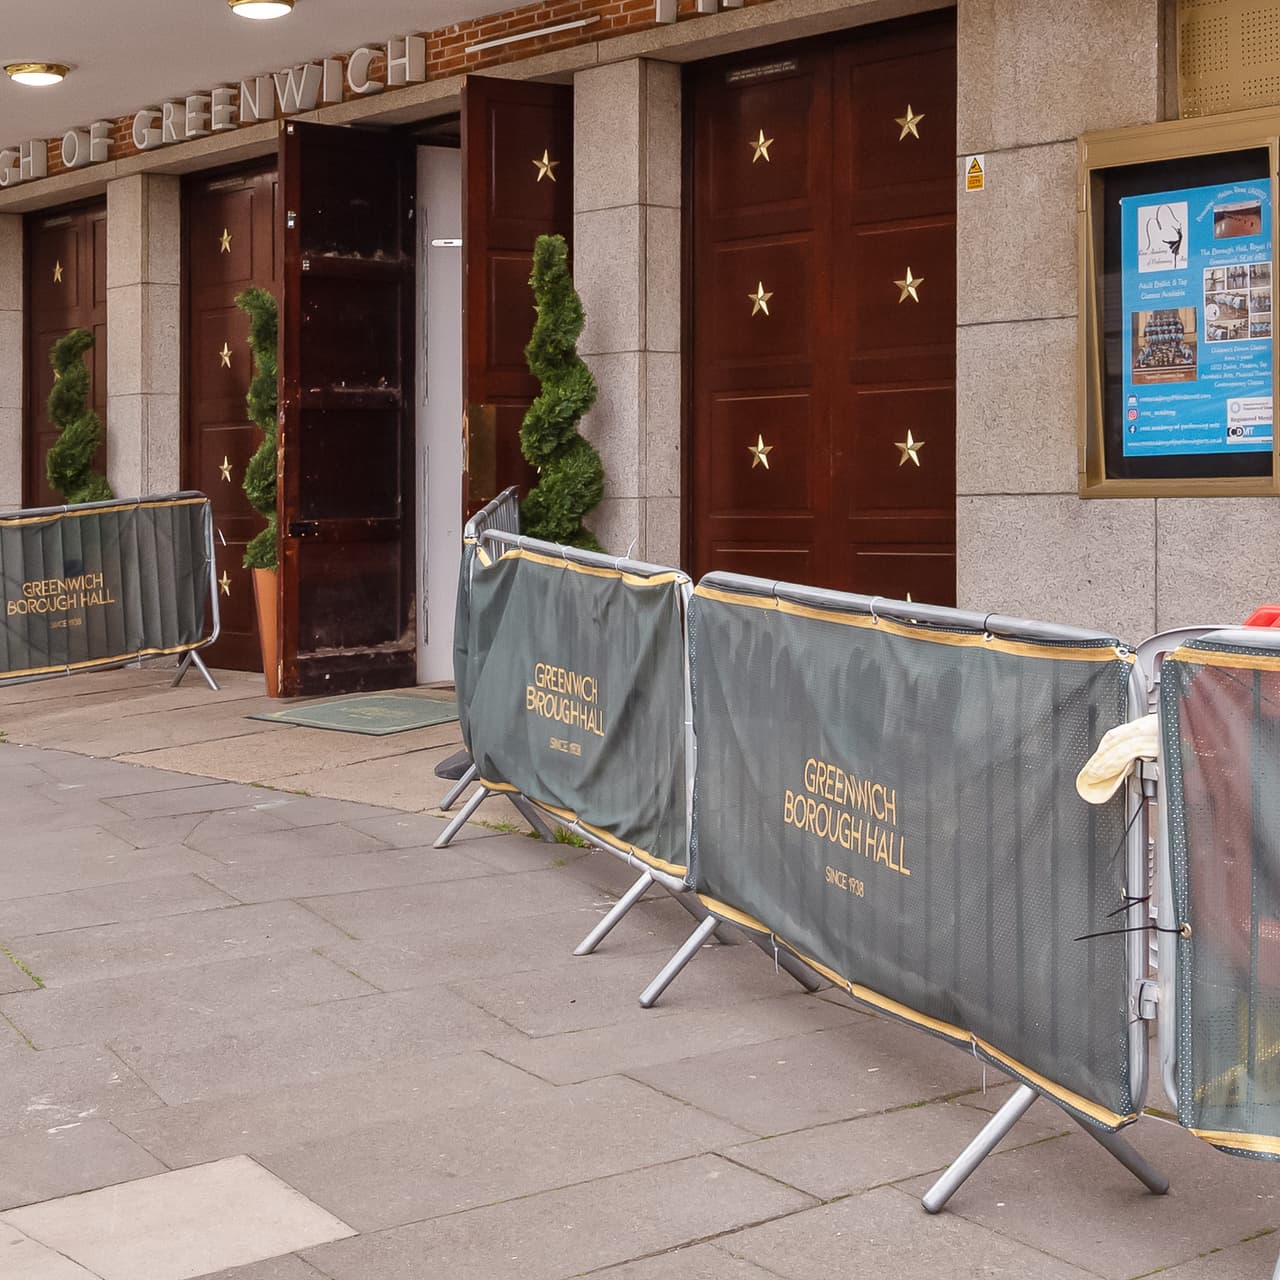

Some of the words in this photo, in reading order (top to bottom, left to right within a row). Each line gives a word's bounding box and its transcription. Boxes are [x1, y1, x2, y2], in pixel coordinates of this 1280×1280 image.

[61, 121, 115, 168] OF
[132, 35, 426, 151] GREENWICH
[7, 593, 77, 616] BOROUGH
[80, 588, 115, 608] HALL
[23, 572, 104, 598] GREENWICH
[535, 662, 598, 705] GREENWCH
[526, 685, 580, 727] BROUGH
[580, 703, 605, 737] HALL
[804, 758, 896, 826] GREENWICH
[784, 790, 863, 854] BOROUGH
[865, 822, 911, 876] HALL
[825, 866, 848, 890] SINCE
